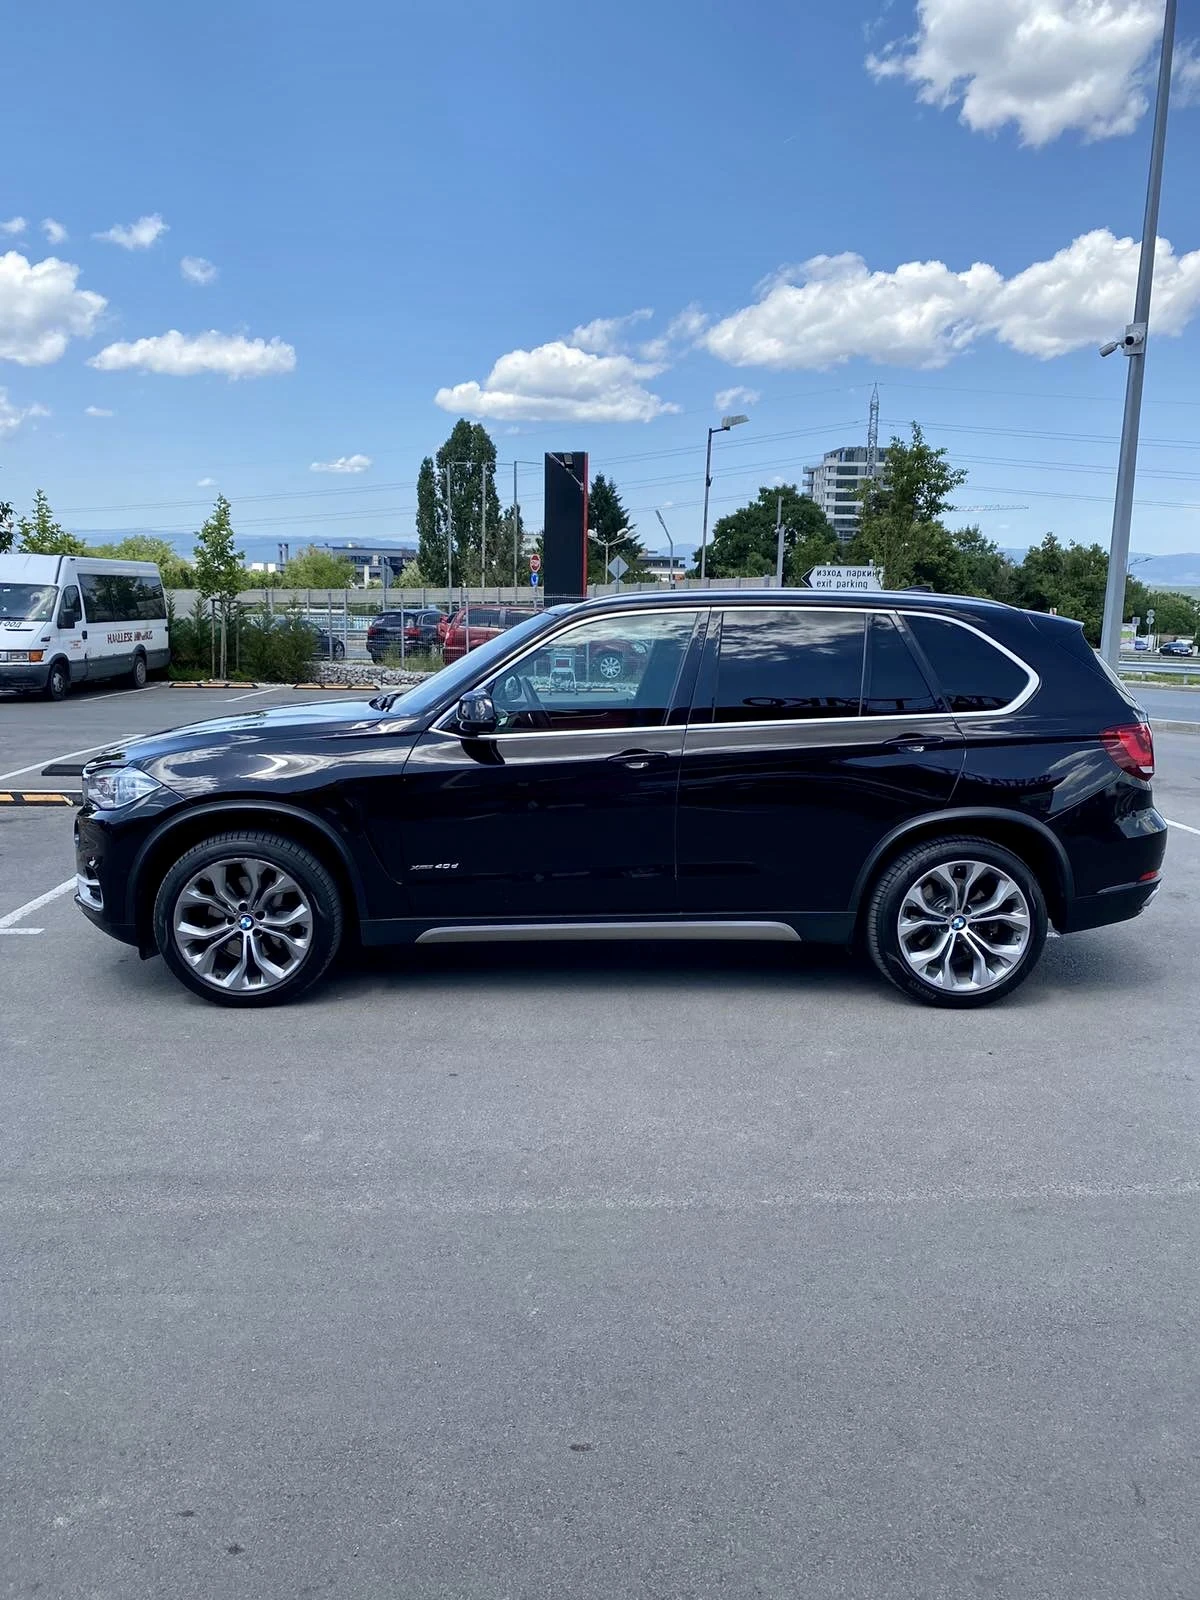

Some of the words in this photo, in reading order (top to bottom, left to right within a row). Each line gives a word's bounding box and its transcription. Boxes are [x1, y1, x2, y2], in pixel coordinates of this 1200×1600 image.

[816, 569, 842, 578] изход
[816, 579, 832, 588] exit
[836, 579, 868, 590] parking
